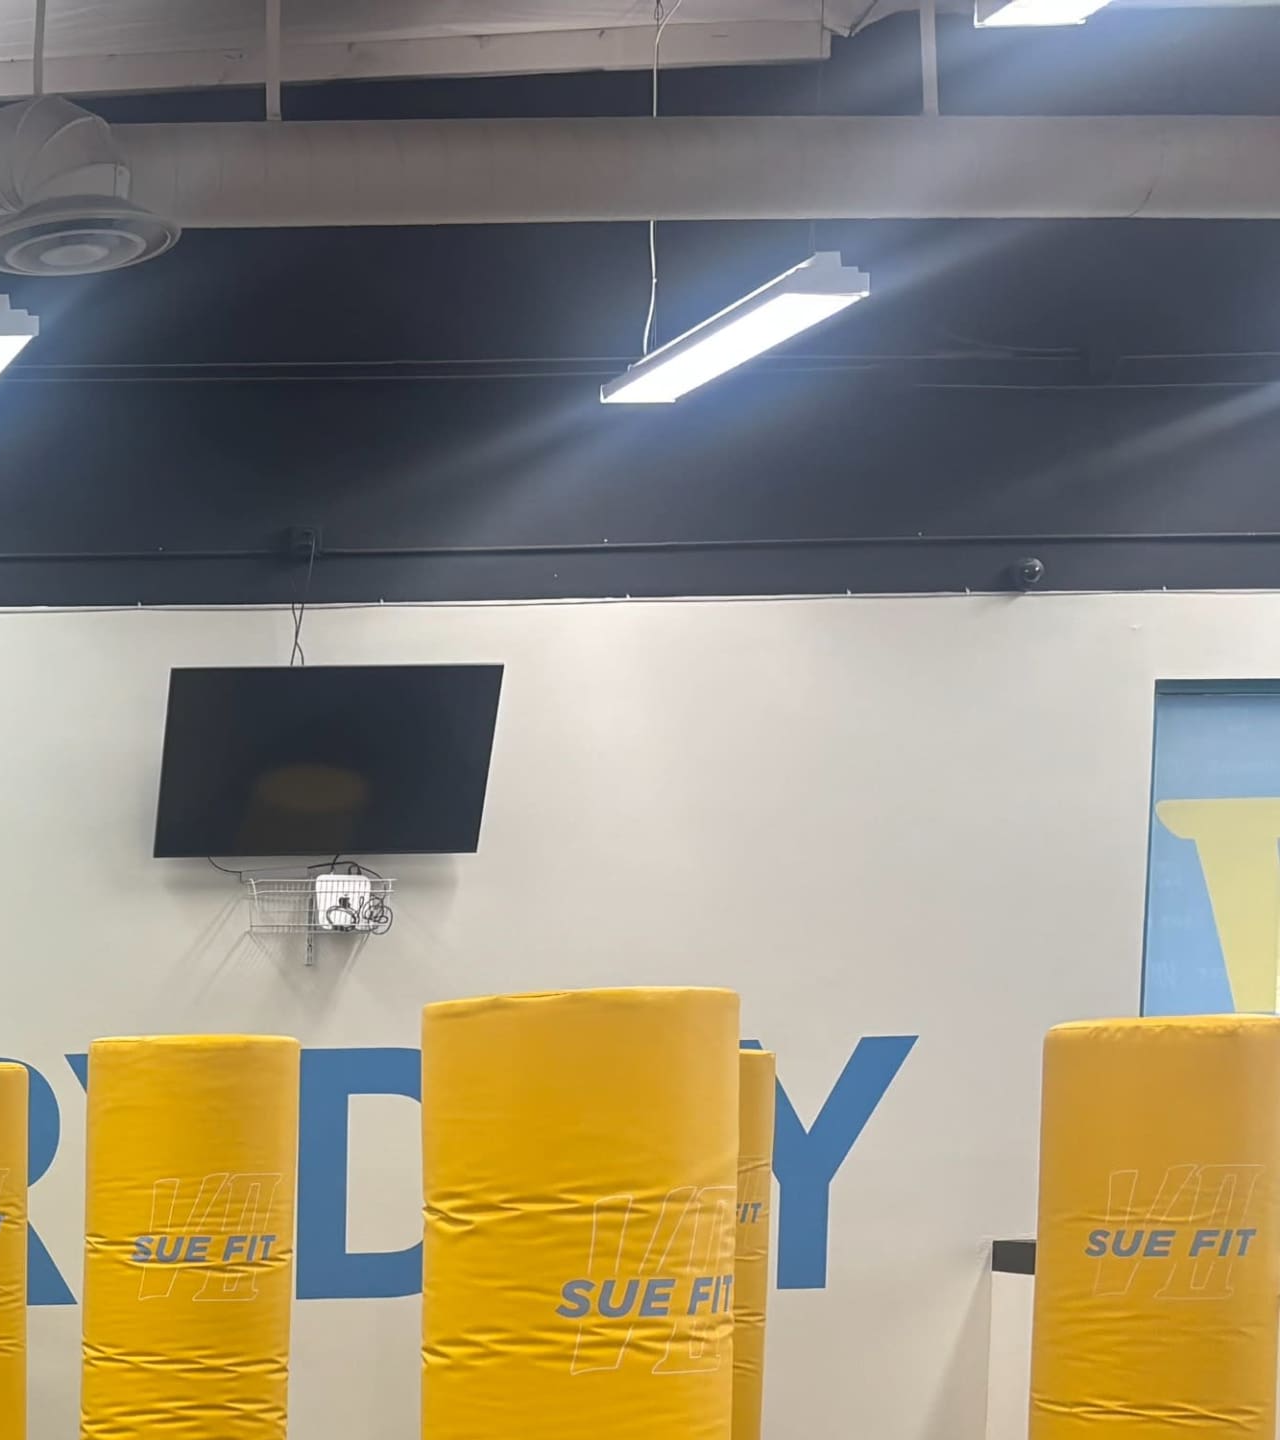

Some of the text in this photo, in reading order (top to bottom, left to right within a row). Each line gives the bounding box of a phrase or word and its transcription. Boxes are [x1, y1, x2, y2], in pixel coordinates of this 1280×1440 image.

[736, 1202, 762, 1224] IT
[132, 1234, 276, 1264] SUE FIT
[1085, 1228, 1257, 1258] SUE FIT
[555, 1278, 676, 1319] SUE
